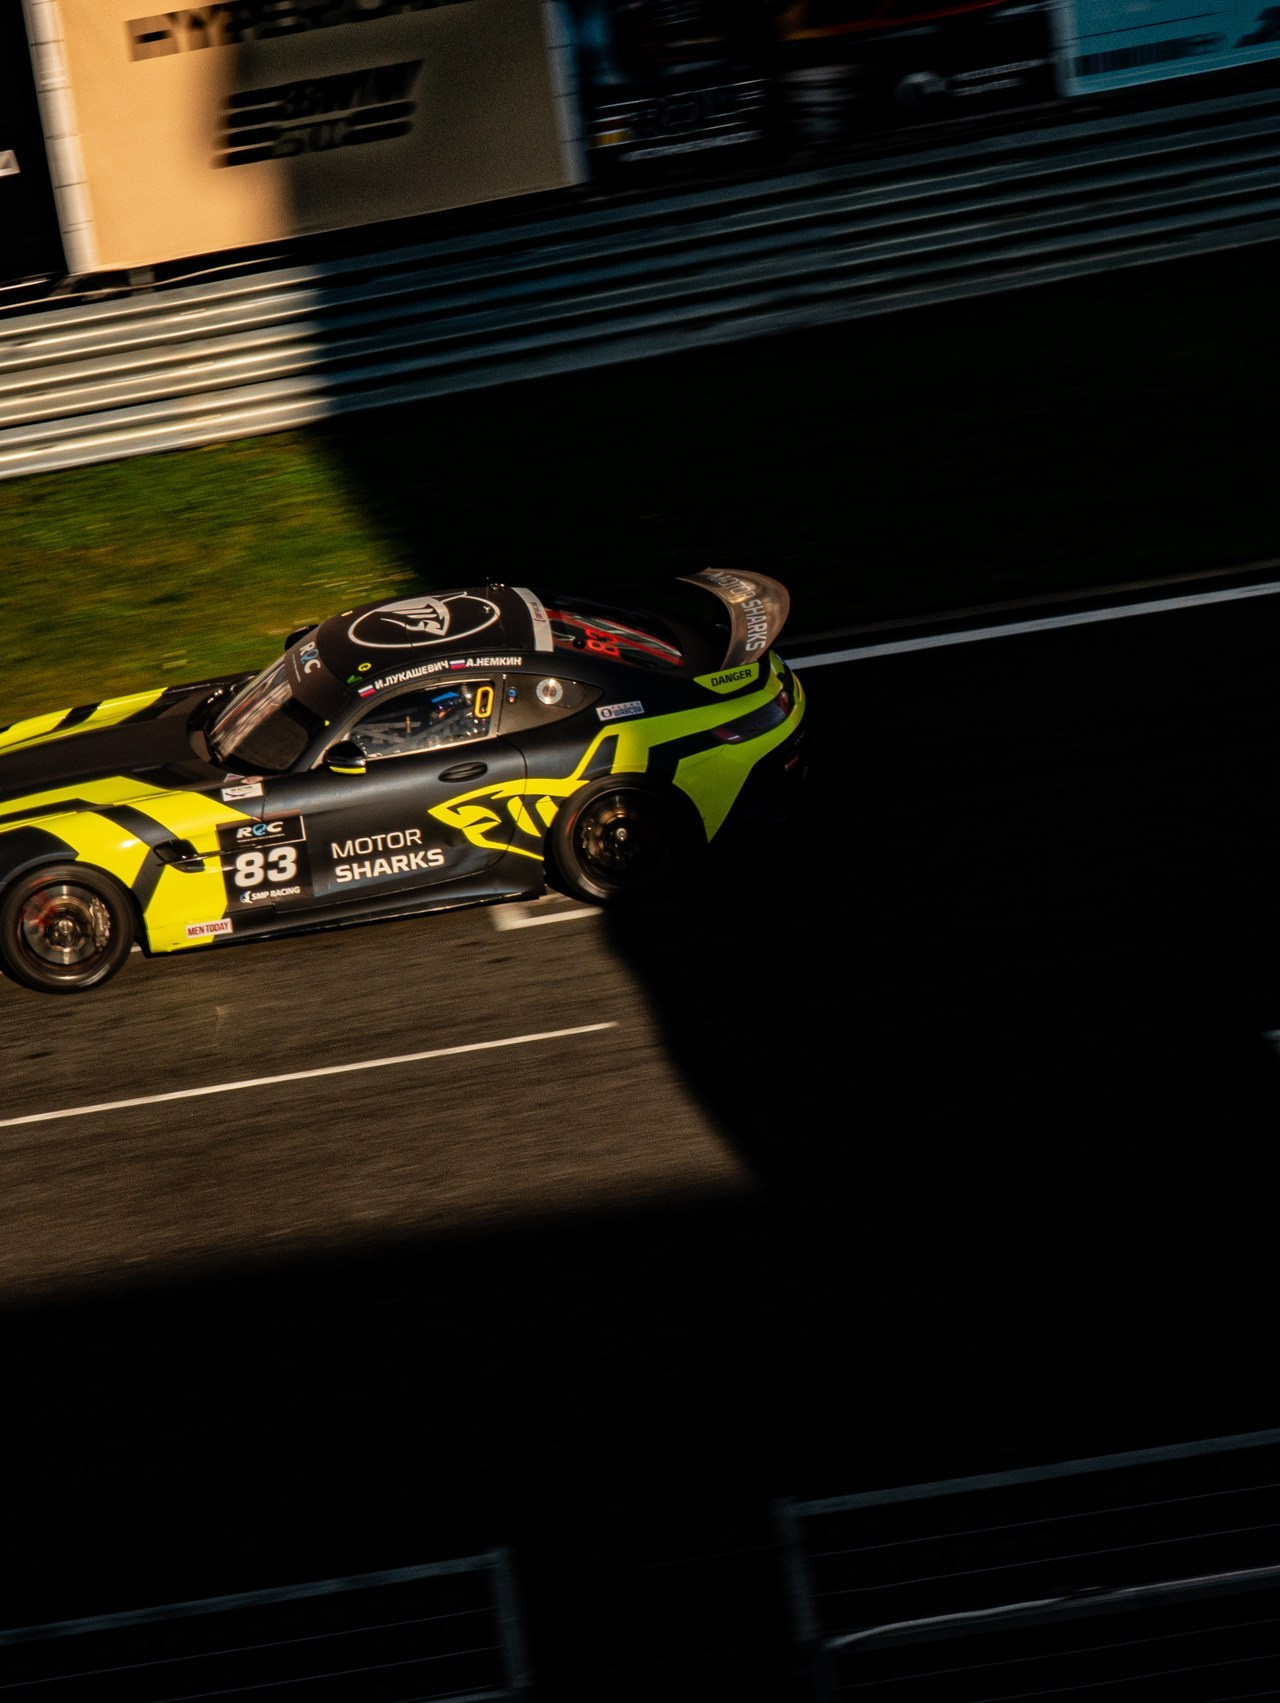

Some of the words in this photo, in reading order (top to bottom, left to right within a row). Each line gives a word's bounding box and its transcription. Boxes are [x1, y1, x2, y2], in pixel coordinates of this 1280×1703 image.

[706, 572, 756, 600] MOTOR
[741, 599, 768, 651] SHARKS
[374, 660, 450, 690] И.ЛУКАШЕВИЧ
[466, 656, 522, 667] А.НЕМКИН
[711, 668, 752, 687] DANGER
[331, 828, 423, 859] MOTOR
[234, 846, 298, 888] 83
[335, 848, 445, 883] SHARKS
[251, 891, 269, 901] SMP
[271, 886, 301, 898] RACING
[187, 926, 205, 936] MEN
[206, 921, 229, 933] TODAY
